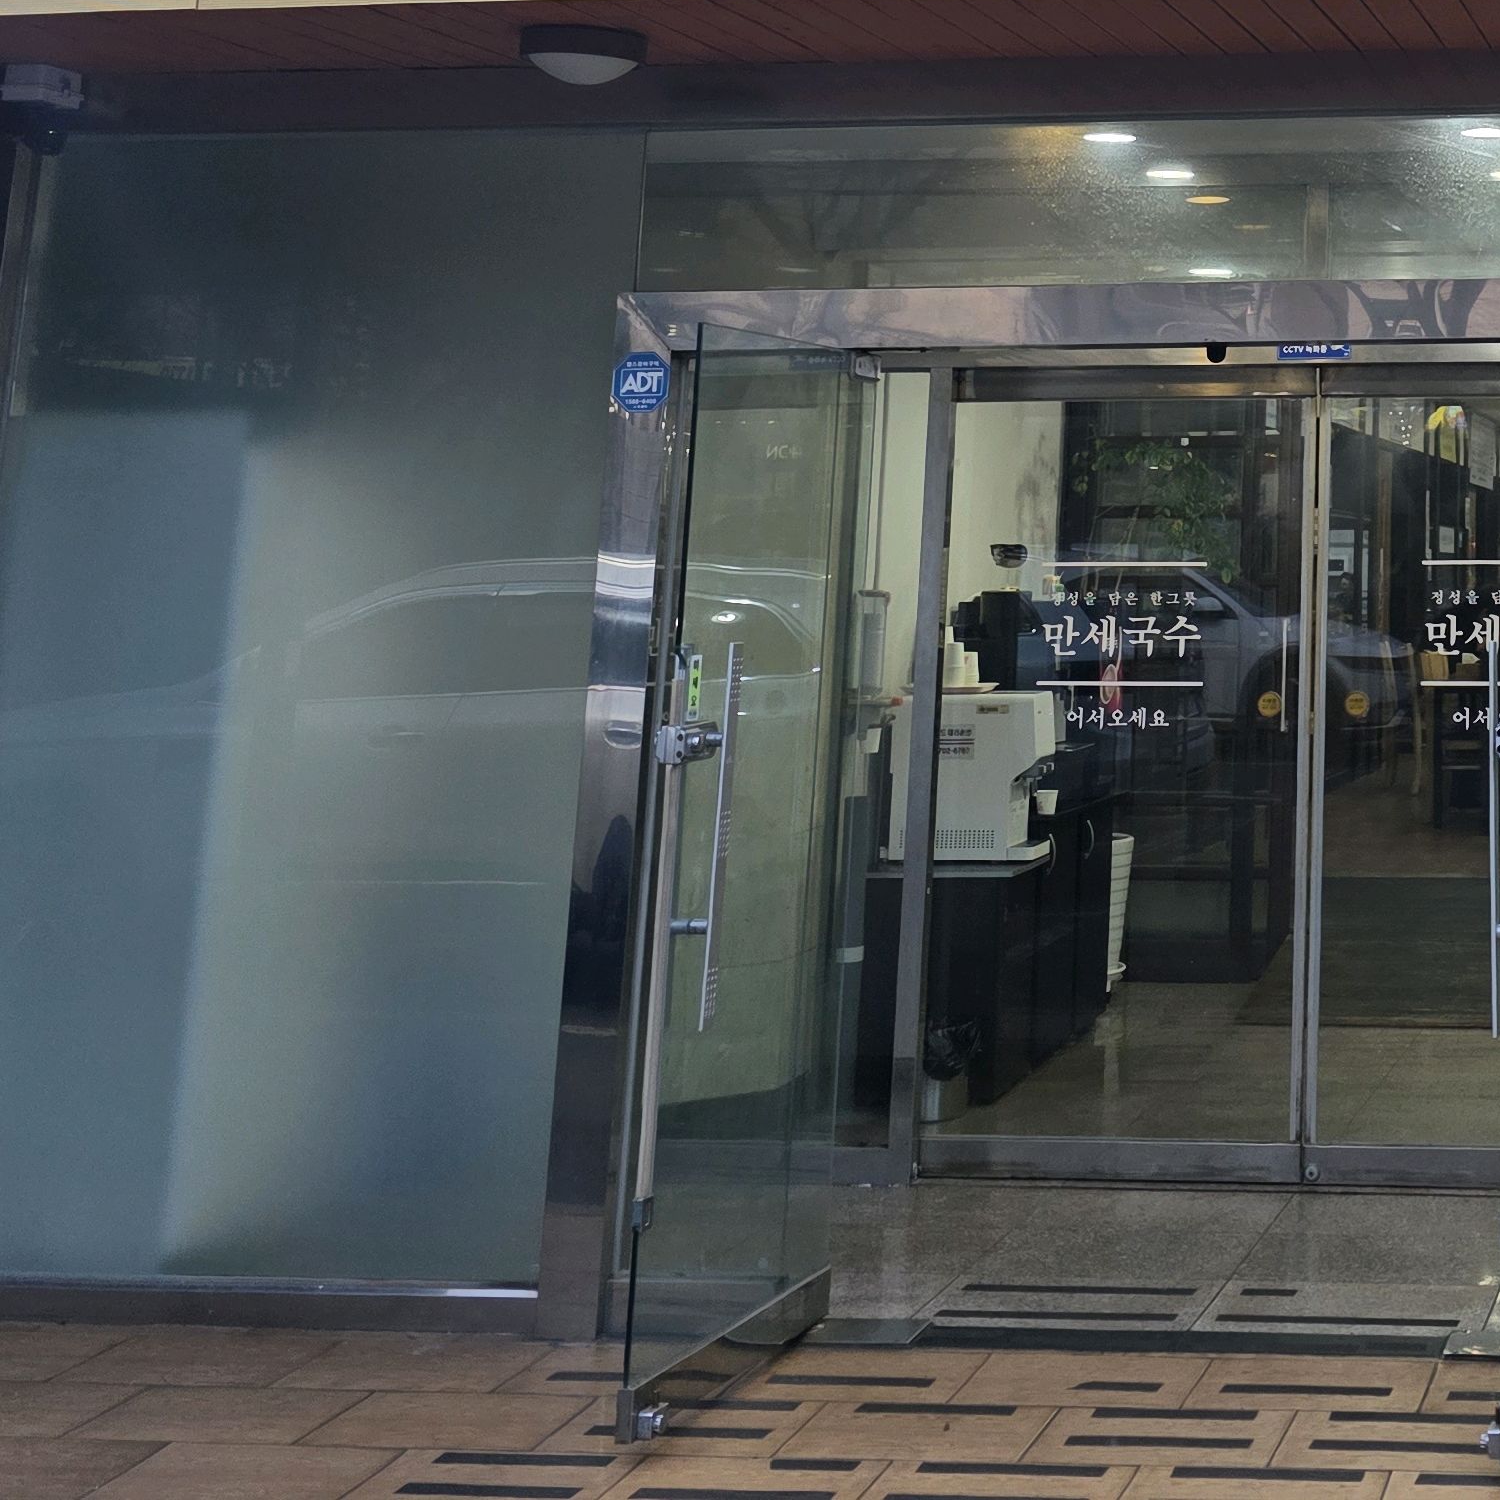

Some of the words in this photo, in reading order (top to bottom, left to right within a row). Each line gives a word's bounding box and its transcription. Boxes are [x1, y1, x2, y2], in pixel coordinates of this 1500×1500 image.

[1282, 345, 1304, 354] CCTV
[620, 372, 663, 394] ADT
[1108, 591, 1139, 606] 담은
[1150, 591, 1198, 606] 한그릇
[1431, 590, 1480, 605] 정성을
[1042, 615, 1202, 658] 만세국수
[1066, 706, 1170, 730] 어서오세요
